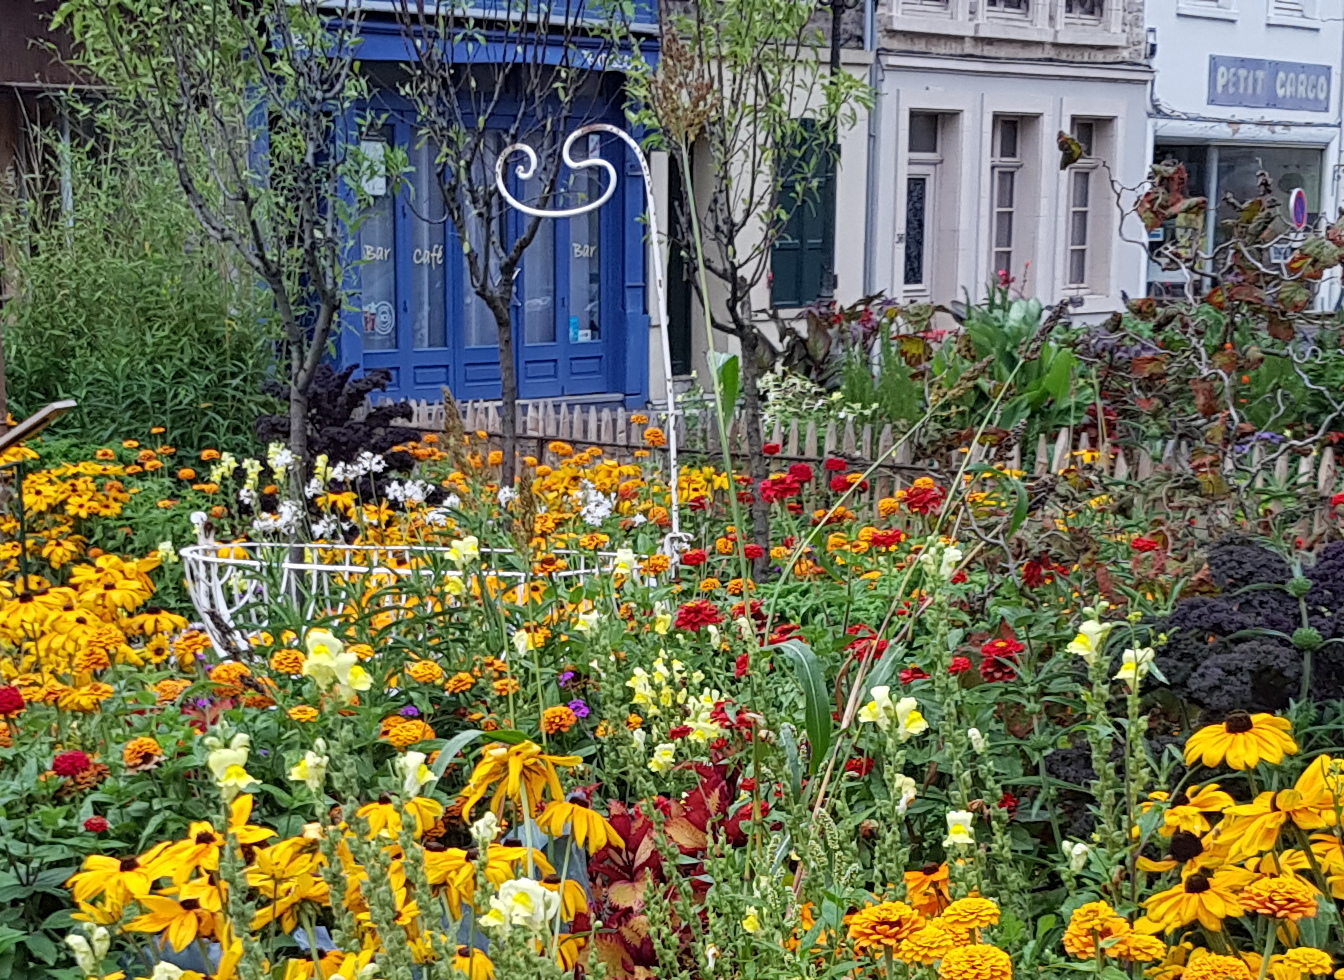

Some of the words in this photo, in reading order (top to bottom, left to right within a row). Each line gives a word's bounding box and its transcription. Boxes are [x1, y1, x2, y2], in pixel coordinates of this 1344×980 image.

[1216, 65, 1266, 95] PETIT
[1276, 70, 1328, 101] CARGO
[364, 244, 391, 261] Bar
[572, 242, 596, 259] Bar
